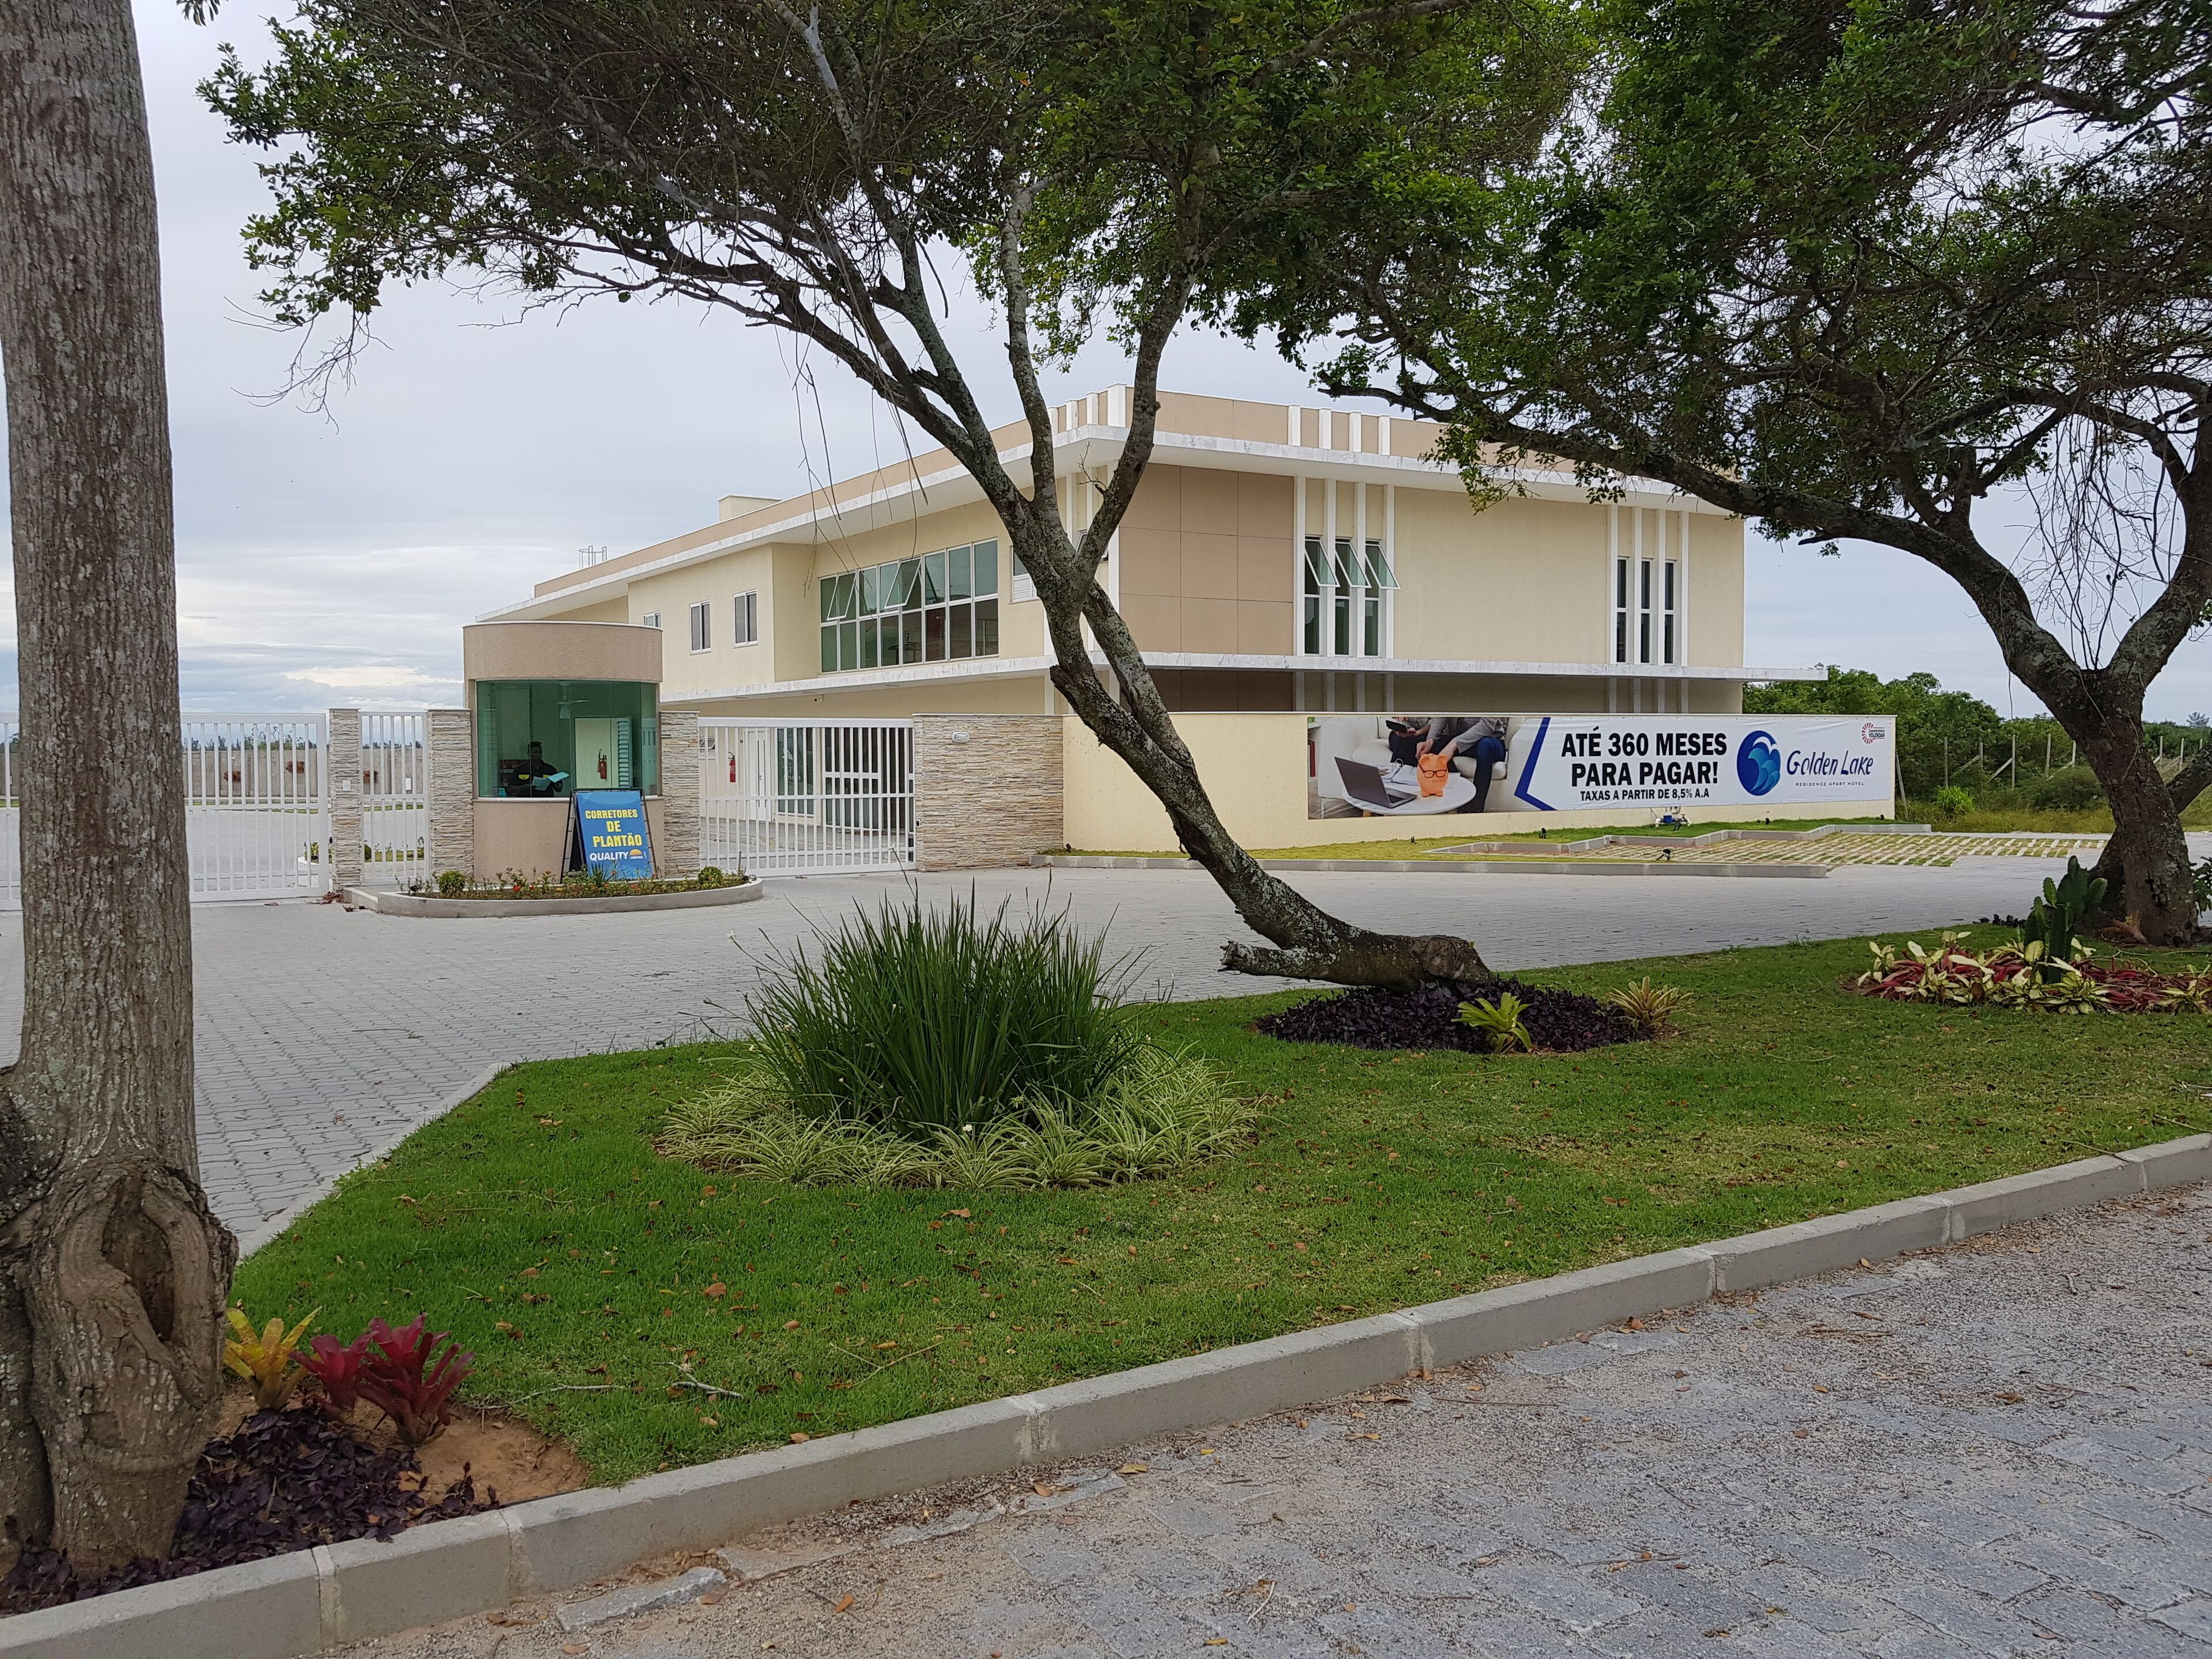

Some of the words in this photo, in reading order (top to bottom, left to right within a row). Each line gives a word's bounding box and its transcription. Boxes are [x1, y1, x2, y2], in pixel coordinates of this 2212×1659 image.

[1561, 725, 1601, 757] ATÉ
[1608, 733, 1649, 756] 360
[1656, 733, 1727, 756] MESES
[1786, 750, 1839, 775] Golden
[1840, 749, 1874, 775] Lake
[1571, 762, 1633, 787] PARA
[1639, 762, 1718, 785] PAGAR!
[1580, 790, 1611, 801] TAXAS
[1613, 790, 1619, 800] A
[1622, 789, 1655, 800] PARTIR
[1658, 789, 1670, 799] DE
[1672, 787, 1692, 801] 8,5%
[1694, 787, 1710, 798] A.A
[585, 809, 638, 819] CORRETORES
[606, 820, 622, 832] DE
[592, 832, 643, 847] PLANTÃO
[589, 851, 629, 861] QUALITY
